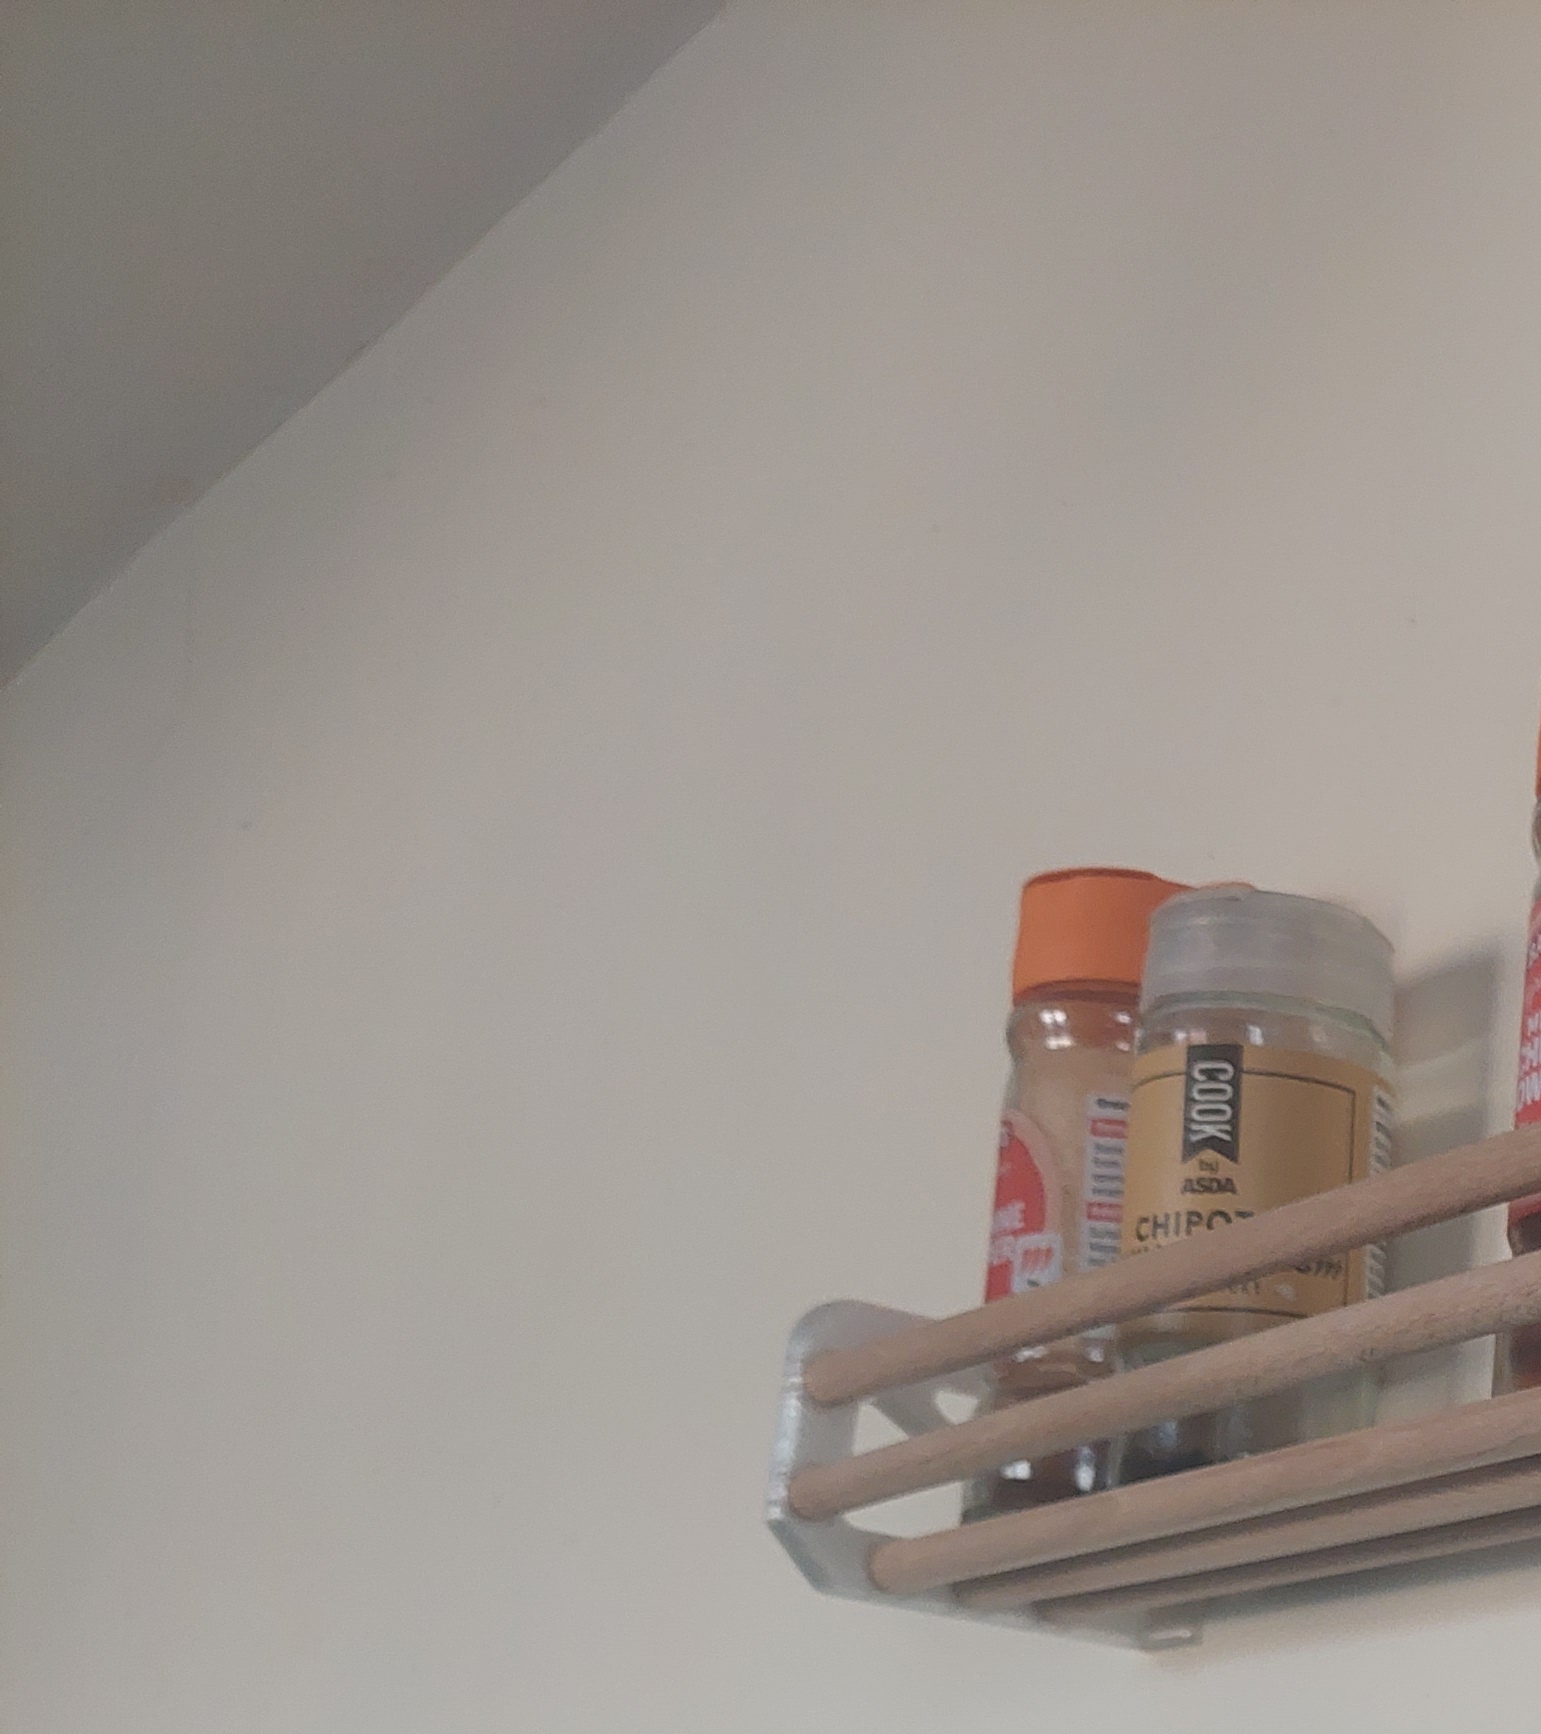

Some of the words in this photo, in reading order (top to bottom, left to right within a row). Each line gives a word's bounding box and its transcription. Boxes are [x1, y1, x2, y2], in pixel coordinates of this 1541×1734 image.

[1190, 1059, 1236, 1143] COOK
[1181, 1176, 1239, 1196] ASDA
[1135, 1209, 1255, 1242] CHIPO
